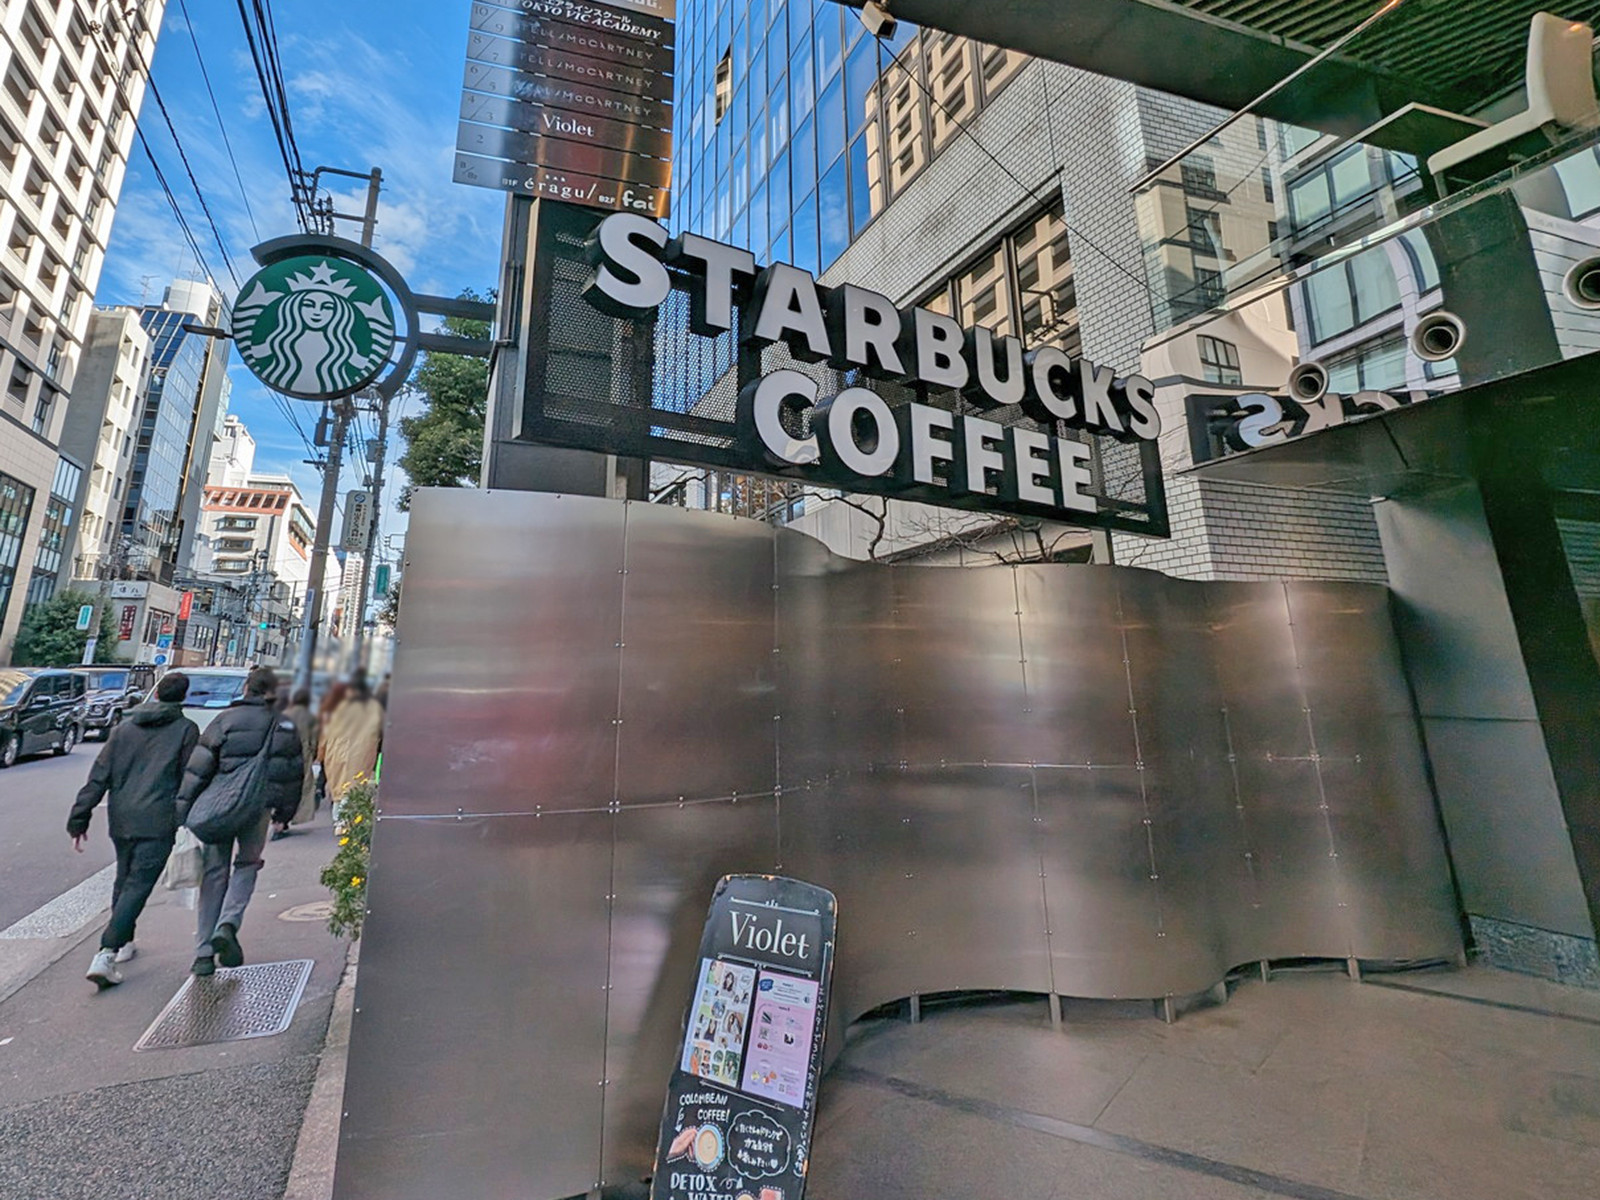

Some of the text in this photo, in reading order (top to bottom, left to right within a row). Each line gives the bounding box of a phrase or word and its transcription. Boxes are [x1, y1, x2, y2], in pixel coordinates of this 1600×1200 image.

[520, 0, 661, 39] OKYO VIC ACADEMY
[542, 113, 595, 137] Violet
[595, 212, 1161, 441] STARBUCKS
[753, 369, 1098, 513] COFFEE
[729, 910, 810, 959] Violet
[670, 1172, 717, 1192] DETOX
